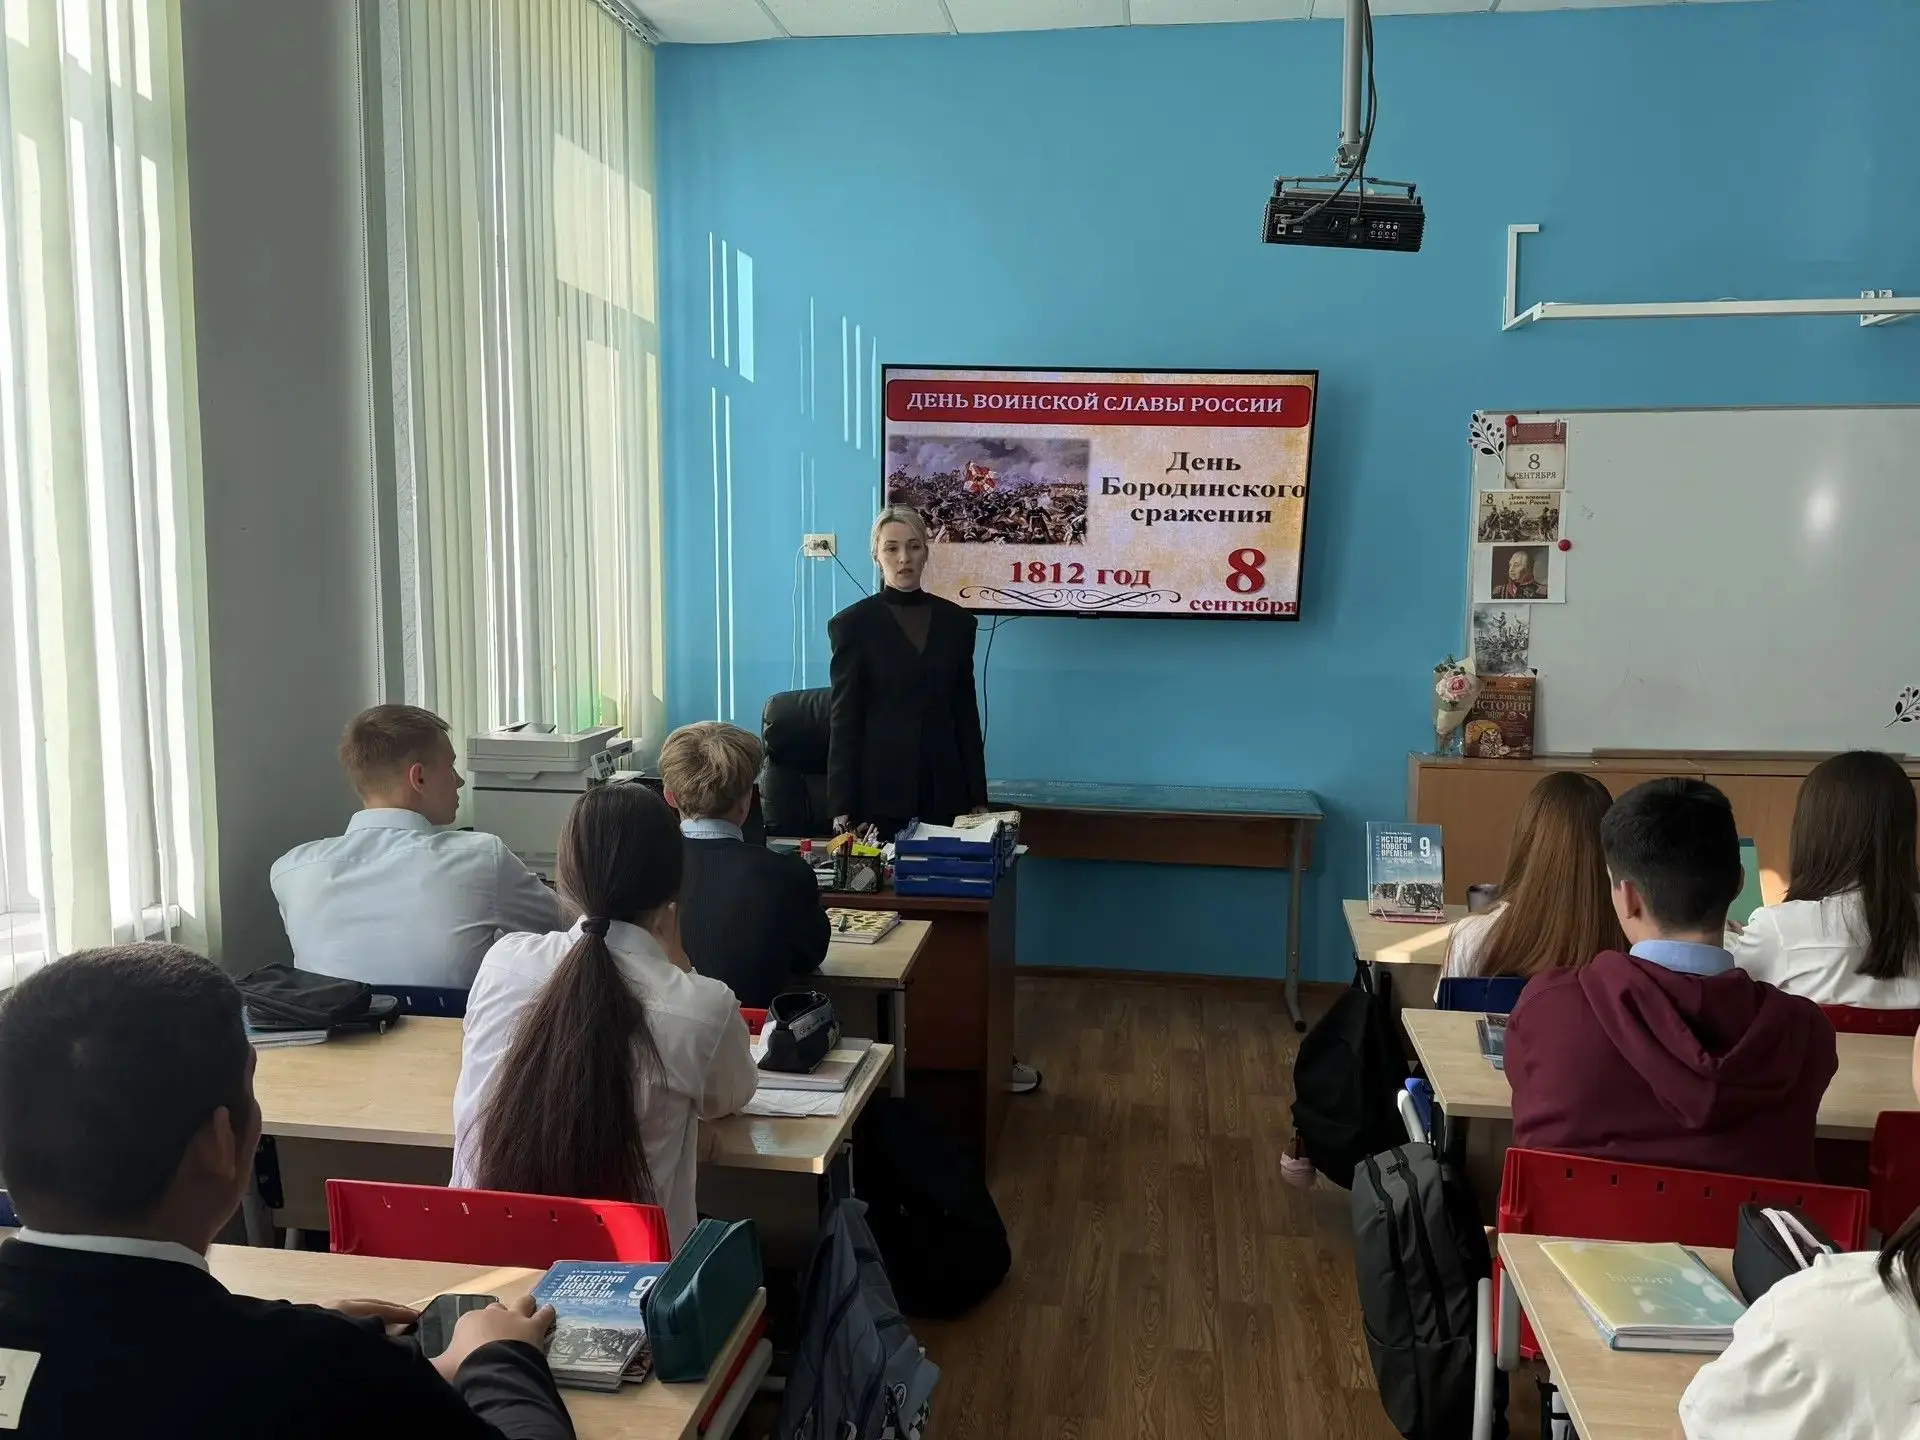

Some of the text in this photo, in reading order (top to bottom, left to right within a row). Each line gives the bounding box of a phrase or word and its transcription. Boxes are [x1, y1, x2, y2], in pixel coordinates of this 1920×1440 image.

[906, 391, 1284, 414] ДЕНЬ ВОИНСКОЙ СЛАВЫ РОССИИ
[1165, 451, 1242, 475] День
[1528, 453, 1540, 470] 8
[1513, 471, 1556, 480] СЕНТЯБРЯ
[1100, 475, 1306, 504] Бородинского
[1486, 493, 1494, 504] 8
[1130, 505, 1273, 526] сражения
[1010, 561, 1152, 589] 1812 год
[1224, 547, 1267, 595] 8
[1188, 596, 1298, 615] сентября
[1381, 836, 1412, 844] ИСТОРИЯ
[1381, 843, 1408, 851] НОВОГО
[1419, 836, 1431, 858] 9
[558, 1281, 612, 1290] НОВОГО
[564, 1274, 626, 1283] ИСТОРИЯ
[628, 1275, 658, 1299] 9
[552, 1289, 616, 1298] ВРЕМЕНИ
